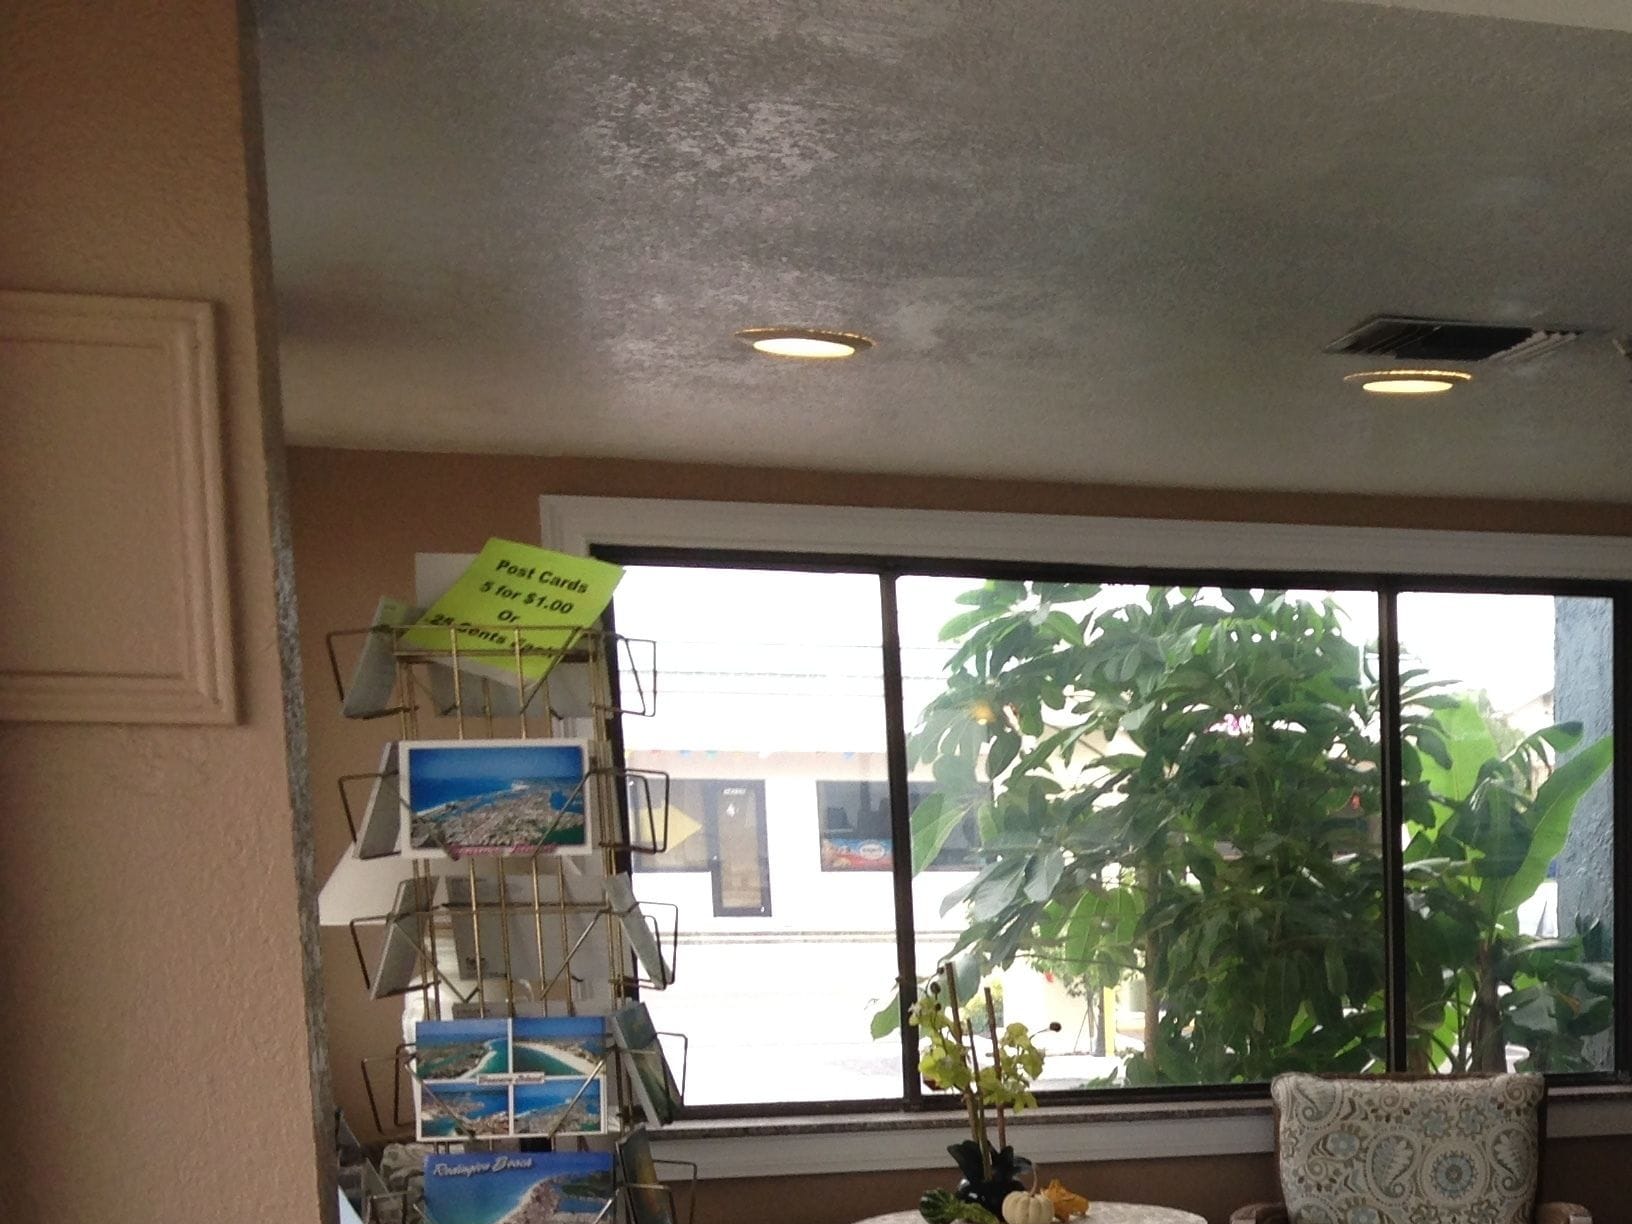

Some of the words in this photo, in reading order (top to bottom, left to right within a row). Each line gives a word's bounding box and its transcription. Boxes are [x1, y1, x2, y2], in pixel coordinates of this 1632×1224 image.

[496, 559, 536, 580] Post
[539, 571, 590, 594] Cards
[480, 581, 494, 593] 5
[495, 585, 522, 600] for
[523, 592, 574, 614] $1.00
[497, 609, 521, 624] Or
[491, 1156, 532, 1173] Beach
